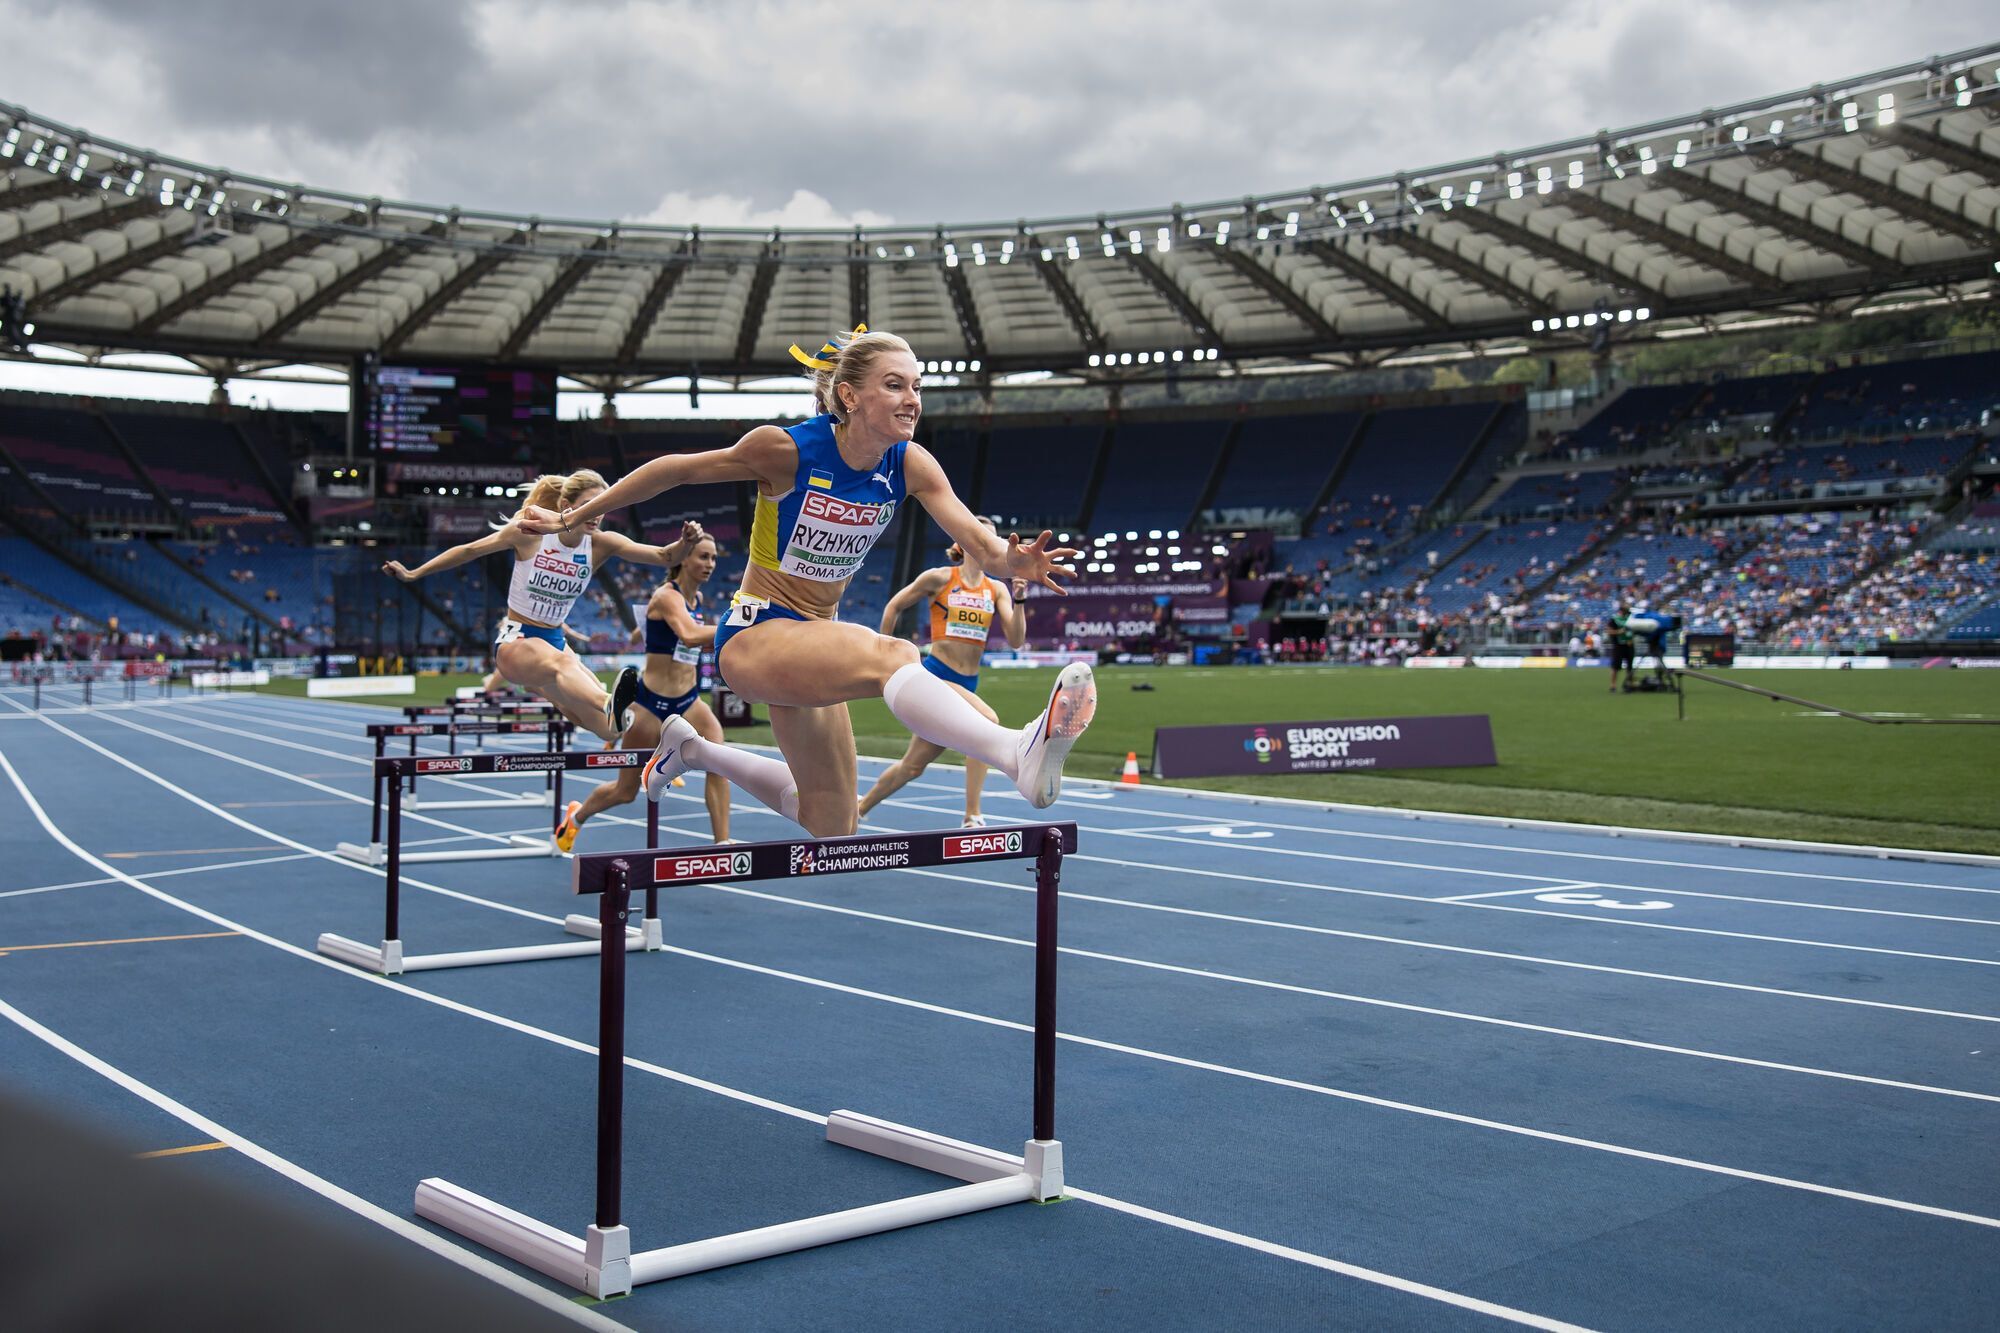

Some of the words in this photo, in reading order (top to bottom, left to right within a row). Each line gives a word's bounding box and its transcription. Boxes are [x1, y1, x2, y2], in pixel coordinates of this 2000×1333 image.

[403, 465, 454, 480] STADIO
[456, 466, 524, 482] OLIMPICO
[807, 496, 878, 524] SPAR
[792, 524, 880, 554] RYZHYKOV
[535, 557, 576, 576] SPAR
[813, 555, 833, 564] RUN
[796, 562, 834, 578] ROMA
[529, 572, 583, 594] JÍCHOVÁ
[529, 593, 552, 605] ROMA
[959, 610, 984, 625] BOL
[1065, 622, 1114, 637] ROMA
[1116, 621, 1156, 636] 2024
[1287, 725, 1401, 744] EUROVISION
[1289, 742, 1350, 759] SPORT
[427, 760, 460, 770] SPAR
[510, 762, 566, 771] CHAMPIONSHIPS
[597, 756, 626, 765] SPAR
[1292, 759, 1329, 769] UNITED
[1330, 759, 1343, 768] BY
[1345, 757, 1376, 768] SPORT
[829, 844, 869, 855] EUROPEAN
[870, 841, 909, 852] ATHLETICS
[960, 837, 1004, 854] SPAR
[675, 857, 730, 876] SPAR
[817, 853, 909, 872] CHAMPIONSHIPS
[1534, 893, 1675, 910] 3
